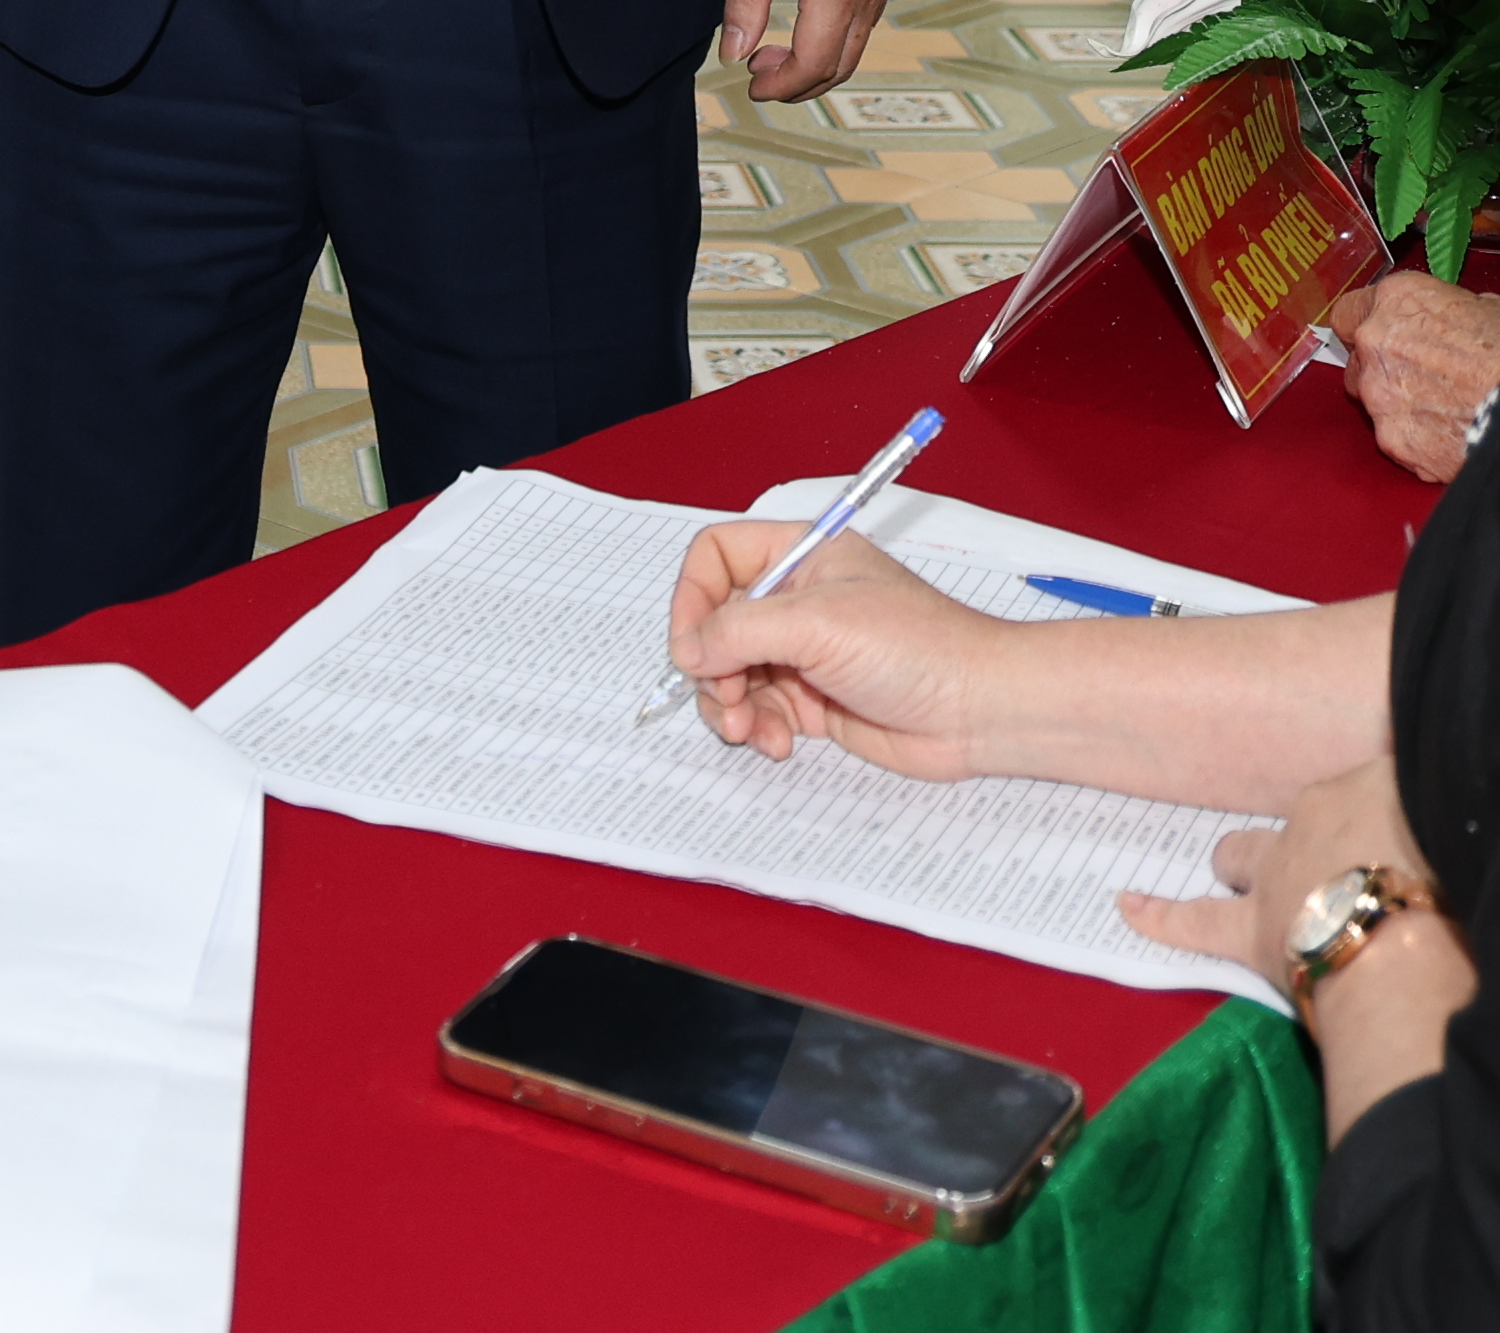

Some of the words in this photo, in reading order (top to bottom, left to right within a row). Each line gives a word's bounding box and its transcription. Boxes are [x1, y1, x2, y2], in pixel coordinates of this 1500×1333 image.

[1157, 171, 1212, 257] BÀN
[1199, 133, 1256, 219] ĐÓNG
[1244, 81, 1285, 174] DẤU
[1237, 224, 1289, 309] BỎ
[1261, 183, 1336, 281] PHIẾU
[1212, 257, 1266, 340] ĐÃ
